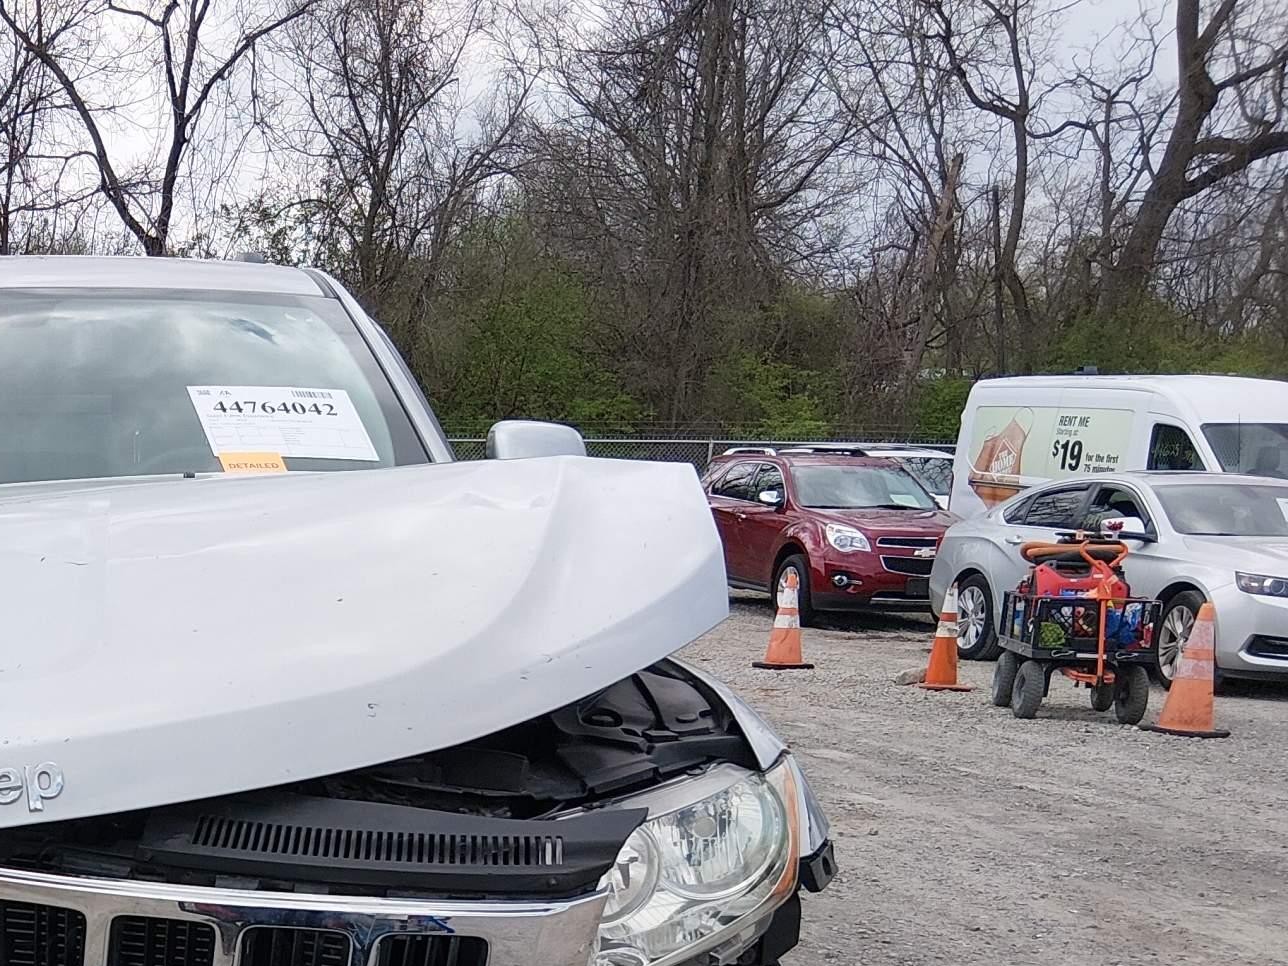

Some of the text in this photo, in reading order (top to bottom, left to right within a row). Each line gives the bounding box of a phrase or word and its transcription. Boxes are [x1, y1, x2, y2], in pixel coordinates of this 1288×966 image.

[213, 400, 338, 416] 44764042
[1059, 416, 1091, 428] RENT ME
[1052, 439, 1083, 472] $19
[1085, 452, 1119, 464] for the first
[1083, 463, 1091, 473] 75
